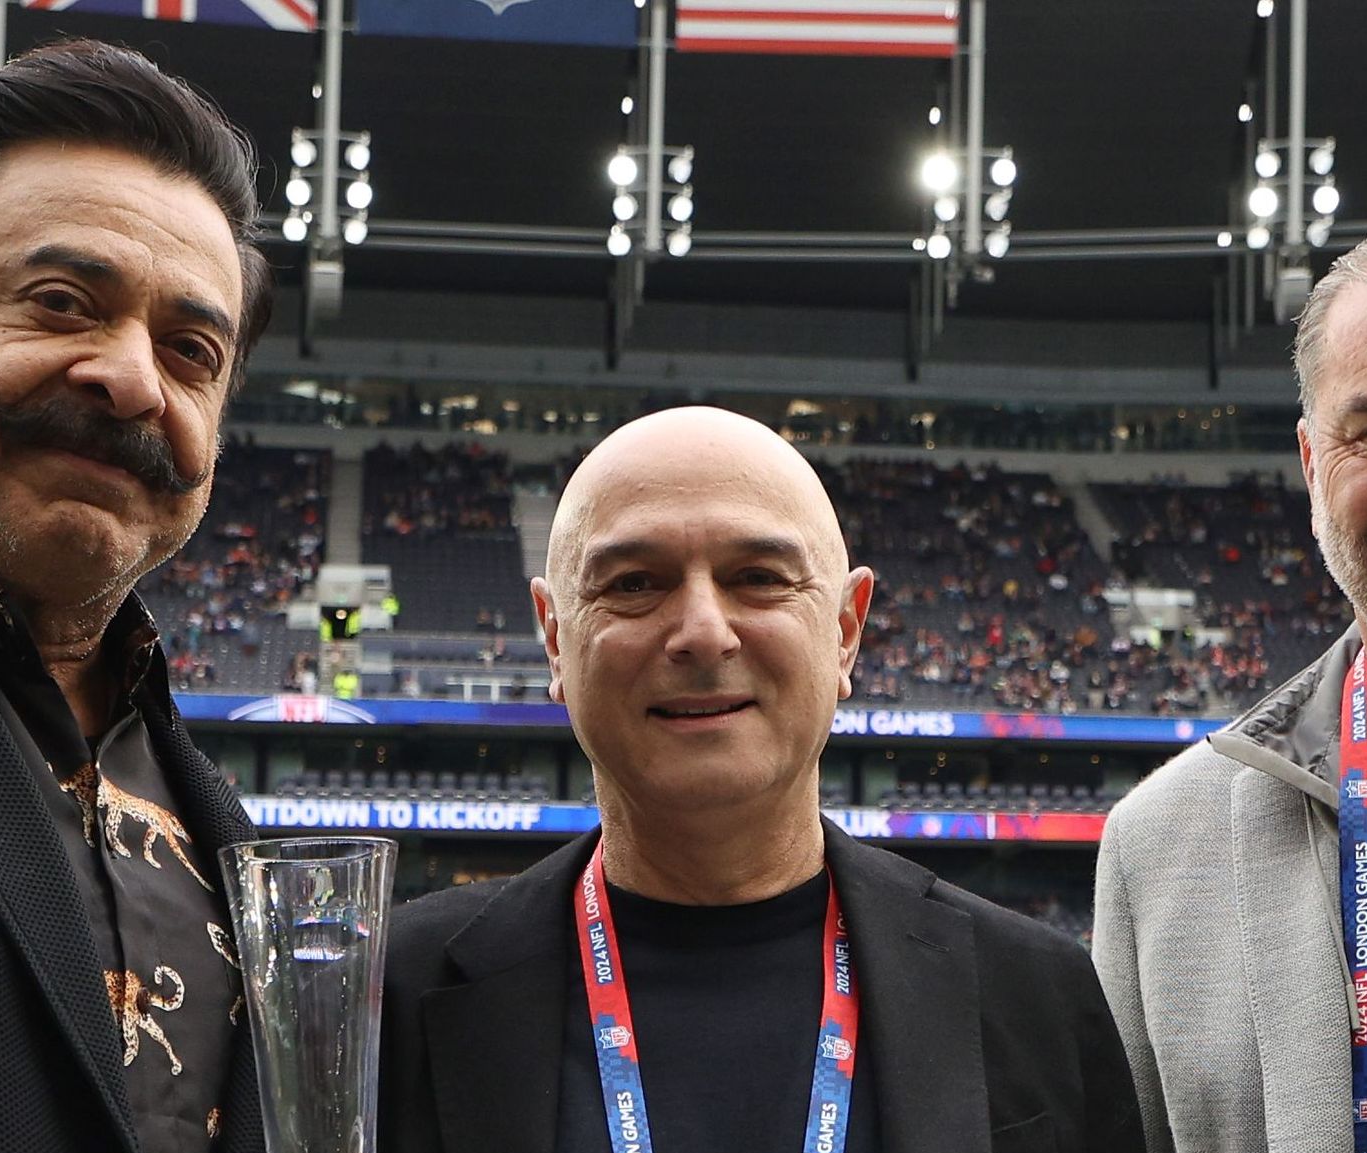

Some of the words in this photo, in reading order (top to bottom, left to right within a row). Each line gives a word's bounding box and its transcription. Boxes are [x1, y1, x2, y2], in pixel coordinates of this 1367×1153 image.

[1353, 686, 1365, 712] NFL
[870, 709, 955, 737] GAMES
[1353, 711, 1366, 741] 2024
[373, 800, 413, 829] TO
[417, 801, 540, 831] KICKOFF
[590, 922, 607, 950] NFL
[596, 950, 613, 984] 2024
[836, 942, 849, 965] NFL
[837, 965, 850, 994] 2024
[617, 1091, 640, 1140] GAMES
